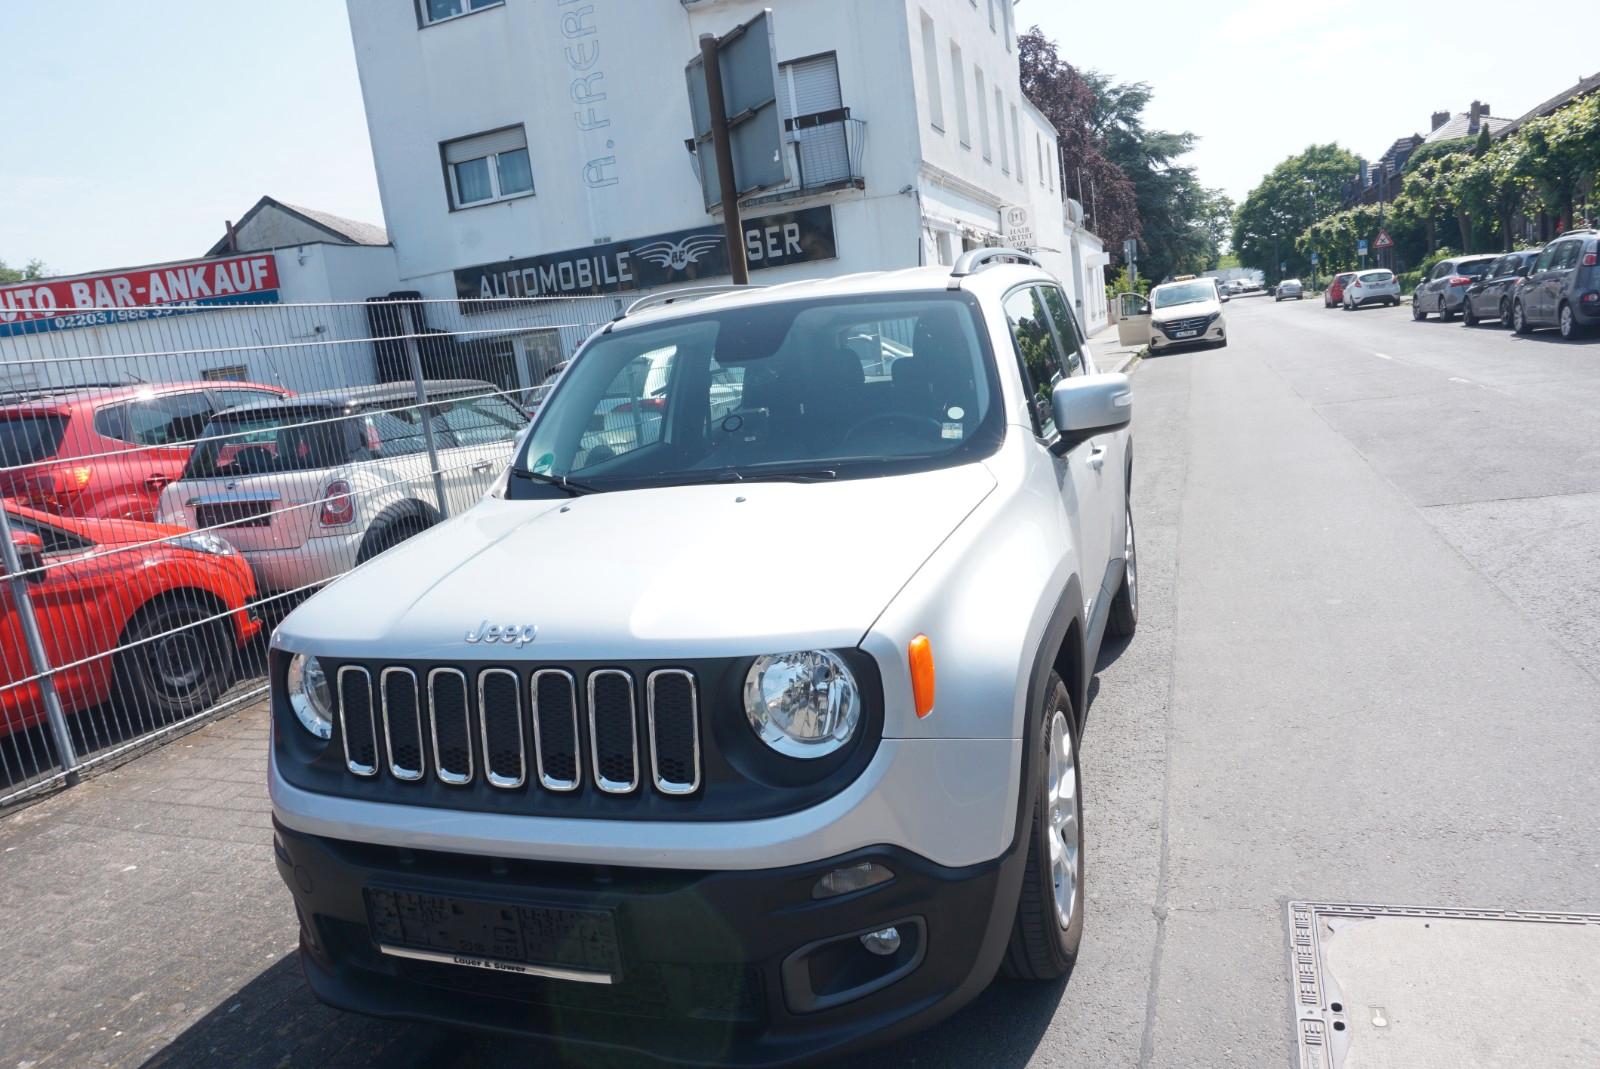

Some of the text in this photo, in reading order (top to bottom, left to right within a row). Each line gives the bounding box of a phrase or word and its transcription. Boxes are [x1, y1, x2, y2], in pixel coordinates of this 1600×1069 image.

[69, 258, 269, 312] BAR-ANKAUF
[478, 251, 633, 299] AUTOMOBILE
[55, 311, 107, 328] 02203
[464, 620, 538, 649] Jeep
